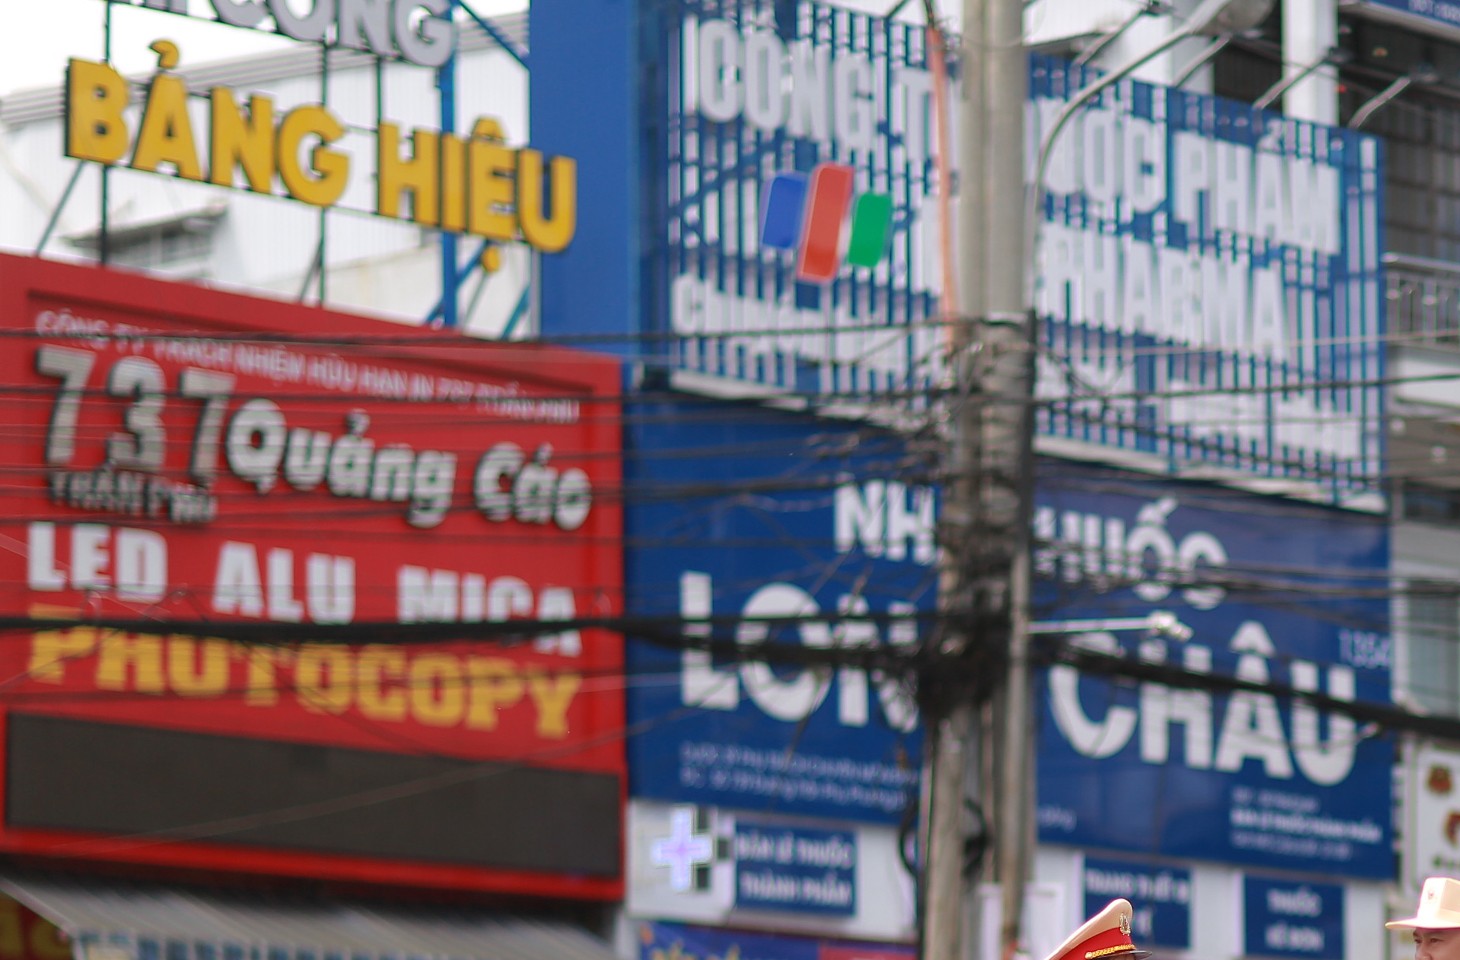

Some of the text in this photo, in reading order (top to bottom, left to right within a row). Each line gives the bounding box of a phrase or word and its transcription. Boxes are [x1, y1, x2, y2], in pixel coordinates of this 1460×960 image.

[66, 40, 578, 273] BẢNG HIỆU
[36, 343, 592, 530] 737 Quảng Cáo
[835, 473, 938, 563] NH
[27, 521, 168, 601] LED
[212, 541, 356, 625] ALU
[1048, 620, 1357, 786] CHÂU
